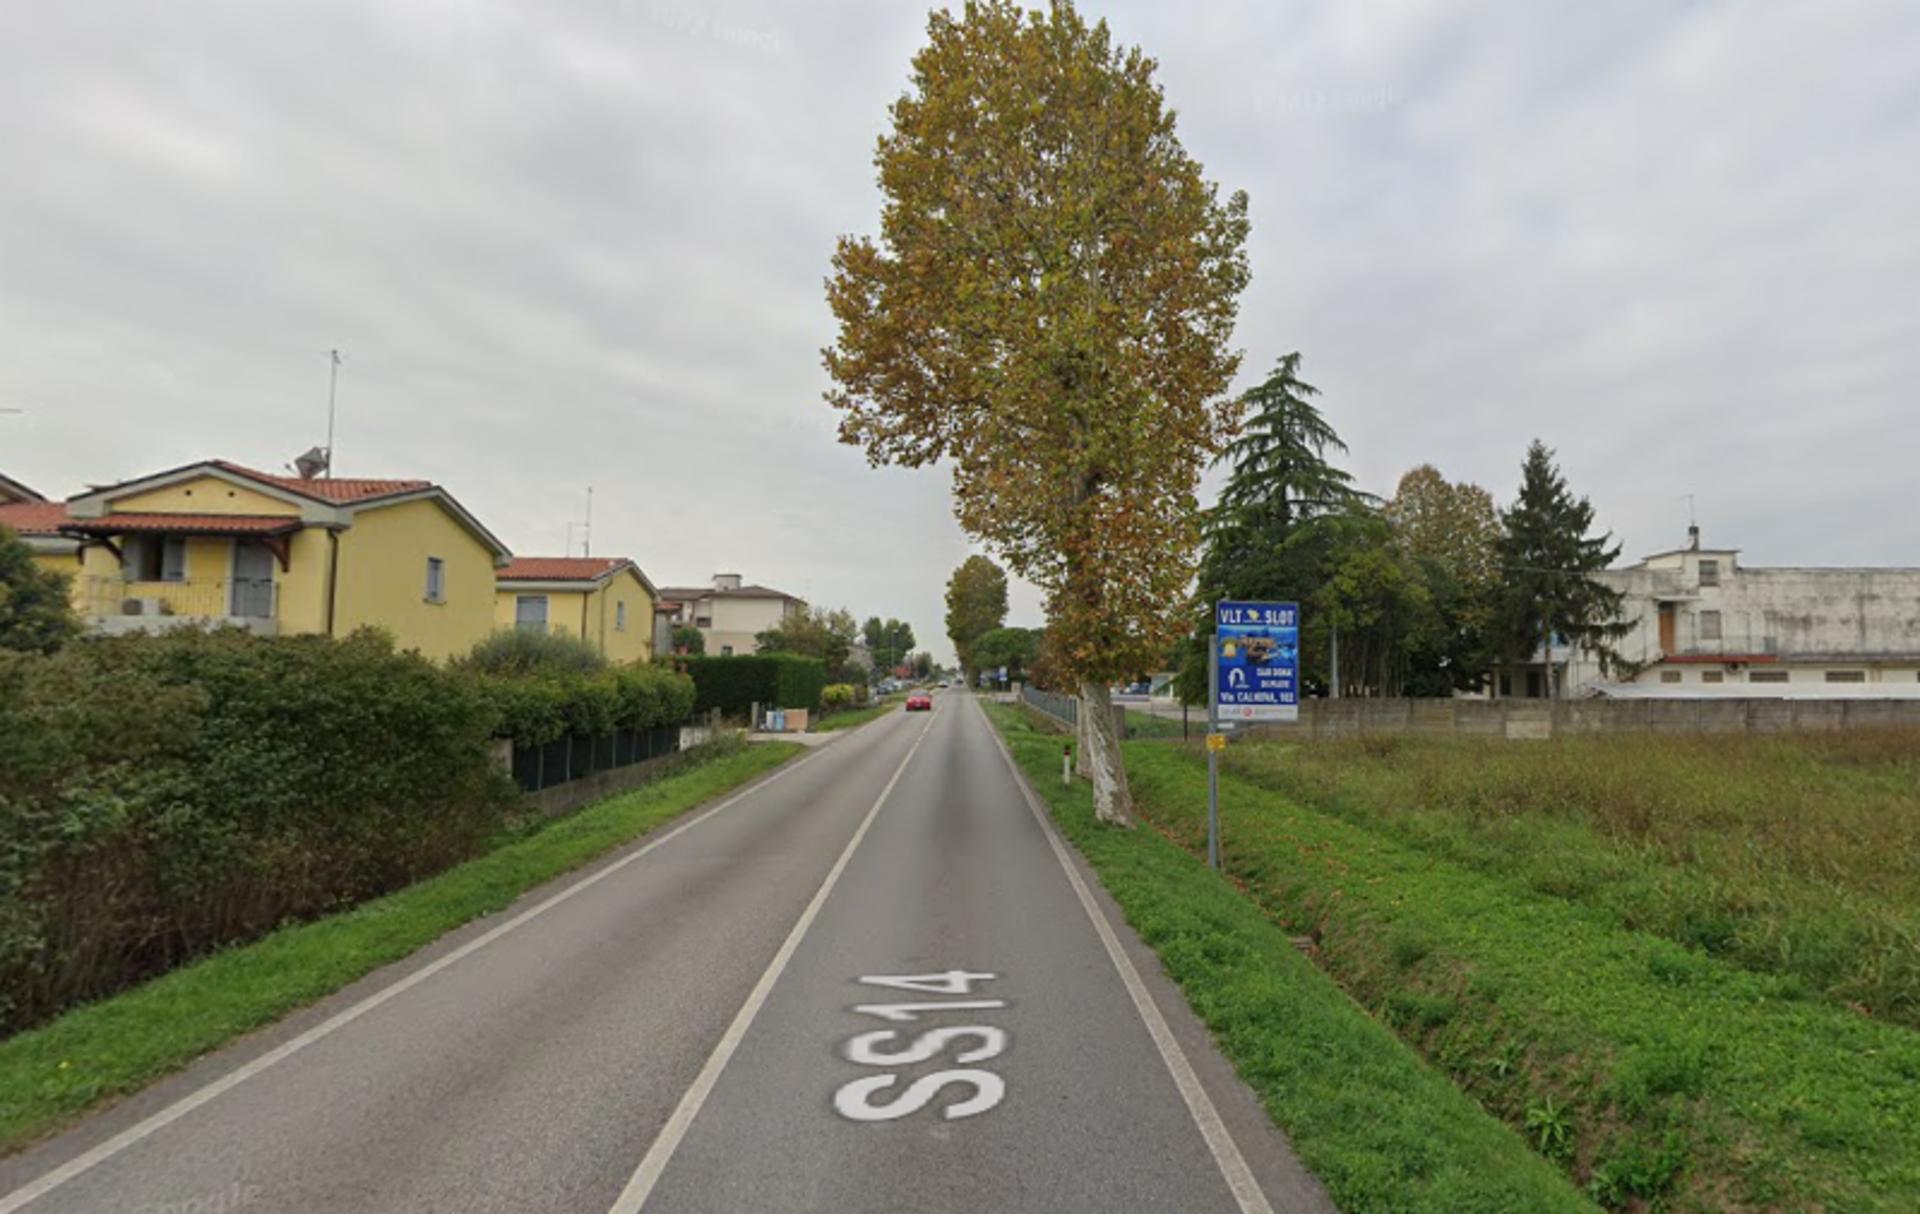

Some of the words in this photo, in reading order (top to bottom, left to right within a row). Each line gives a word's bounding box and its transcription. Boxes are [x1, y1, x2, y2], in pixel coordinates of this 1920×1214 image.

[1220, 608, 1242, 624] VLT
[1265, 609, 1294, 625] SLOT
[834, 970, 1006, 1120] SS14
